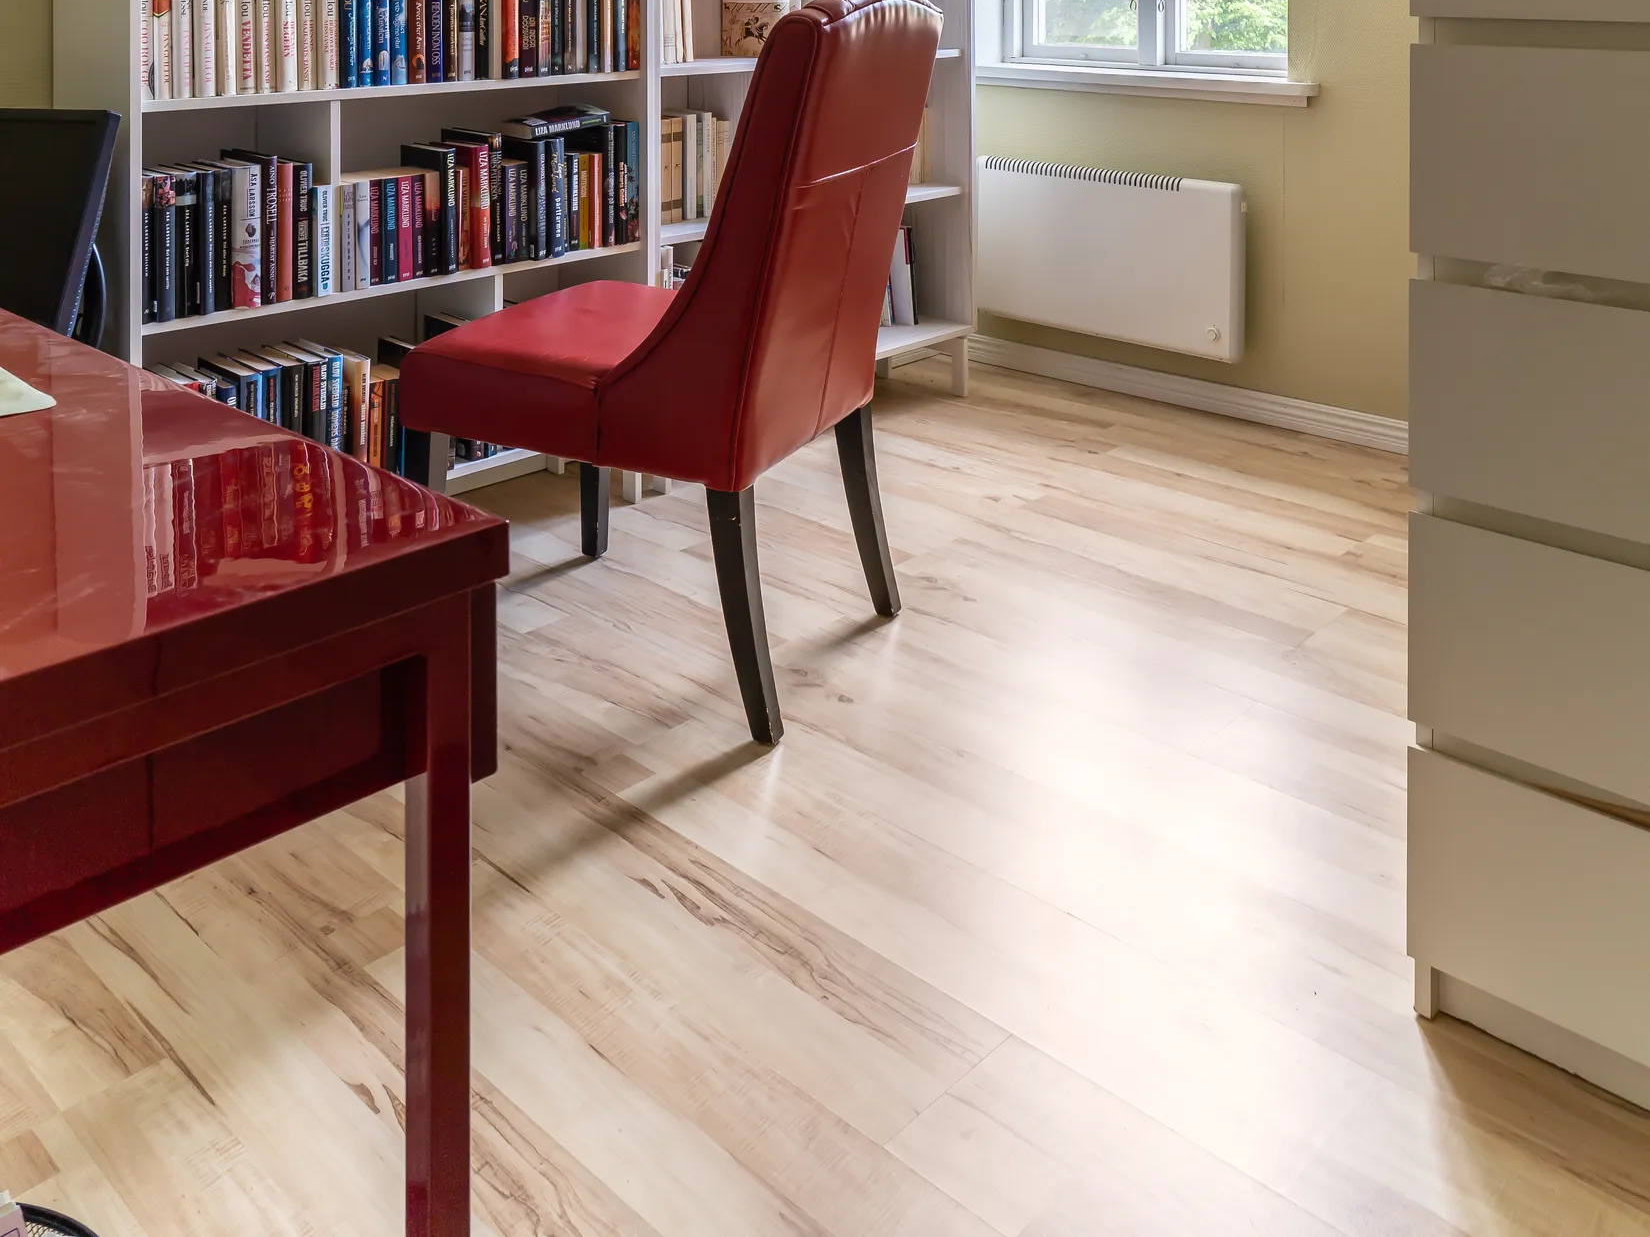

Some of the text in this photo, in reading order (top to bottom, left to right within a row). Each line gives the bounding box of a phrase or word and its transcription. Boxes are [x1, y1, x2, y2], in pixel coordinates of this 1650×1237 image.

[241, 20, 251, 81] VENDETTA
[431, 1, 440, 65] FIENDEN INOM OSS
[535, 119, 580, 135] LIZA MARKLUND
[248, 173, 259, 218] ÅSA LARSSON
[299, 170, 307, 212] OLIVIER TRUC
[414, 182, 422, 195] LIZA
[447, 153, 455, 207] LIZA MARKLUND
[479, 151, 490, 210] LIZA MARKLUND
[489, 151, 498, 201] JAMES PATTERSON
[508, 168, 516, 182] LIZA
[266, 185, 277, 225] TROSELL
[370, 187, 379, 234] LIZA MARKLUND
[387, 183, 395, 230] LIZA MARKLUND
[401, 181, 410, 228] LIZA MARKLUND
[415, 196, 423, 229] MARKLUND
[508, 182, 516, 217] MARKLUND
[520, 186, 528, 222] MARKLUND
[297, 241, 309, 283] TILLBAKA
[321, 247, 330, 284] SKUGGA
[331, 361, 340, 437] OLOV SVEDELID DOMENS
